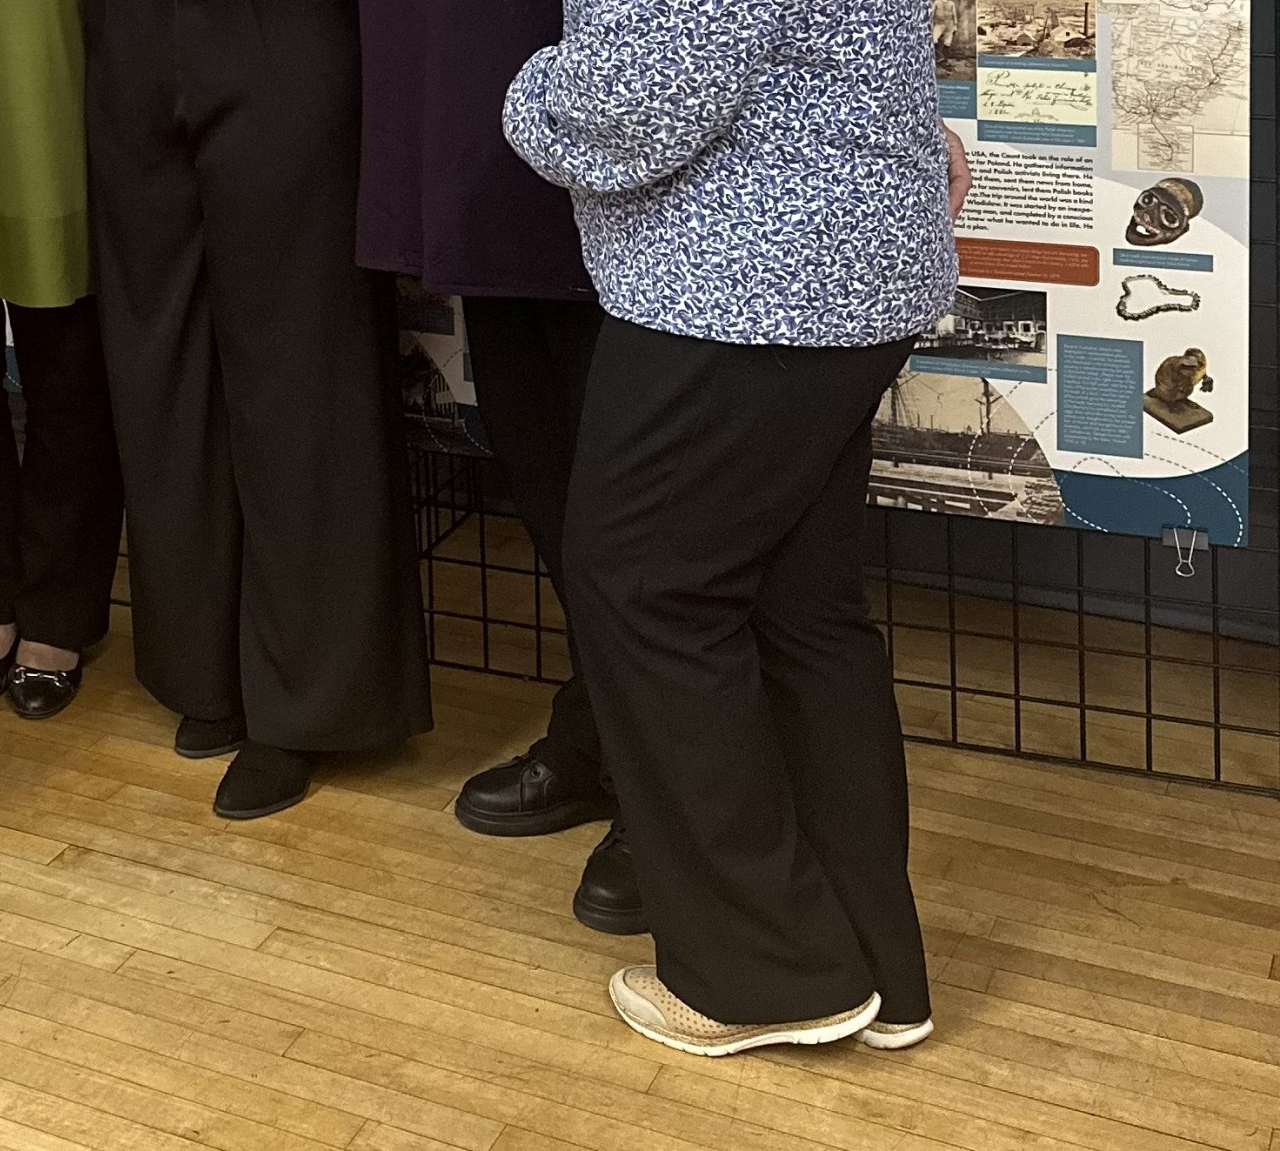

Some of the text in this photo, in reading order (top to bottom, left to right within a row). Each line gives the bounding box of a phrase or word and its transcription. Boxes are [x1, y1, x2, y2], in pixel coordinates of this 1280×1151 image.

[971, 150, 987, 158] USA,
[1001, 151, 1020, 159] Count
[987, 159, 1011, 167] Poland.
[1023, 161, 1053, 171] gathered
[1054, 163, 1093, 171] information
[978, 166, 991, 174] and
[993, 167, 1012, 175] Polish
[1014, 168, 1040, 176] activists
[1041, 170, 1060, 179] living
[1061, 171, 1080, 179] there.
[983, 175, 1001, 183] them,
[1072, 180, 1092, 189] home,
[988, 183, 1020, 192] souvenirs,
[1072, 188, 1093, 196] books
[991, 191, 1002, 200] trip
[1003, 192, 1026, 200] around
[1027, 193, 1037, 201] the
[1039, 194, 1057, 202] world
[1023, 201, 1046, 209] started
[1047, 203, 1055, 212] by
[967, 214, 984, 222] knew
[986, 215, 1003, 223] what
[1004, 216, 1013, 224] he
[1015, 217, 1040, 225] wanted
[999, 208, 1012, 216] and
[1013, 209, 1046, 220] completed
[1047, 211, 1055, 220] by
[1062, 212, 1093, 221] conscious
